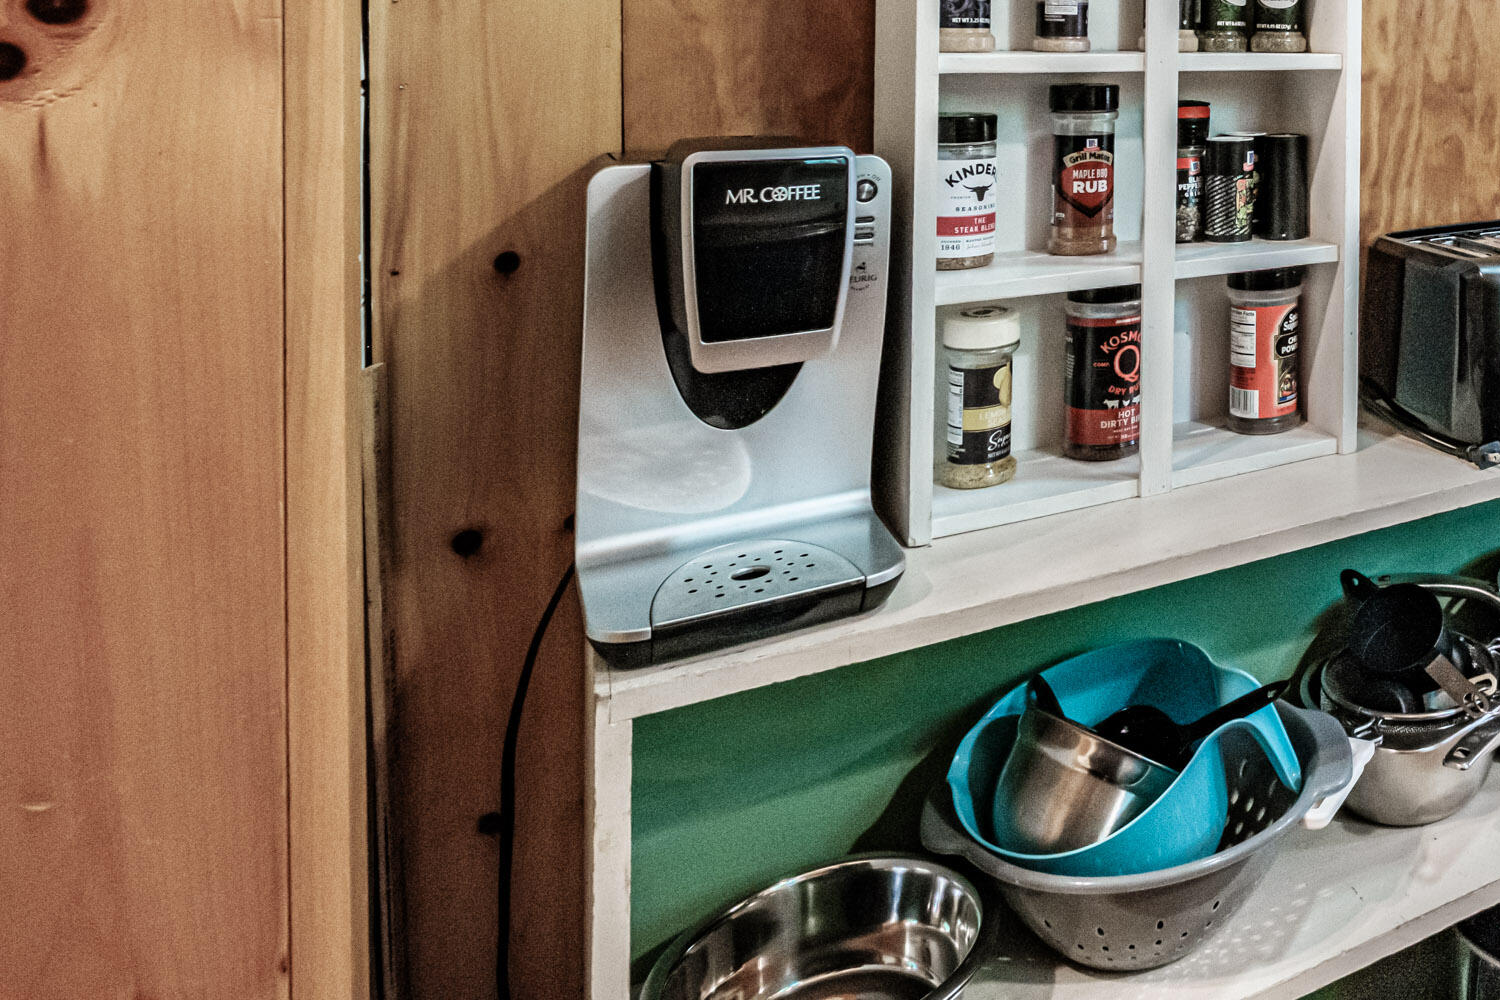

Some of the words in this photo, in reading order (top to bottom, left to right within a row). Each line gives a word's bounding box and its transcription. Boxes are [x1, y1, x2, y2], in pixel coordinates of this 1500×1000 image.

[1069, 152, 1087, 163] Grill
[1072, 169, 1096, 179] MAPLE
[1072, 179, 1108, 194] RUB
[760, 184, 820, 203] COFFEE
[974, 216, 987, 225] THE
[954, 225, 979, 234] STEAK
[850, 274, 878, 284] EURIG
[1114, 344, 1140, 382] Q
[1108, 384, 1127, 396] DRY
[1118, 408, 1136, 419] HOT
[1100, 417, 1128, 429] DIRTY
